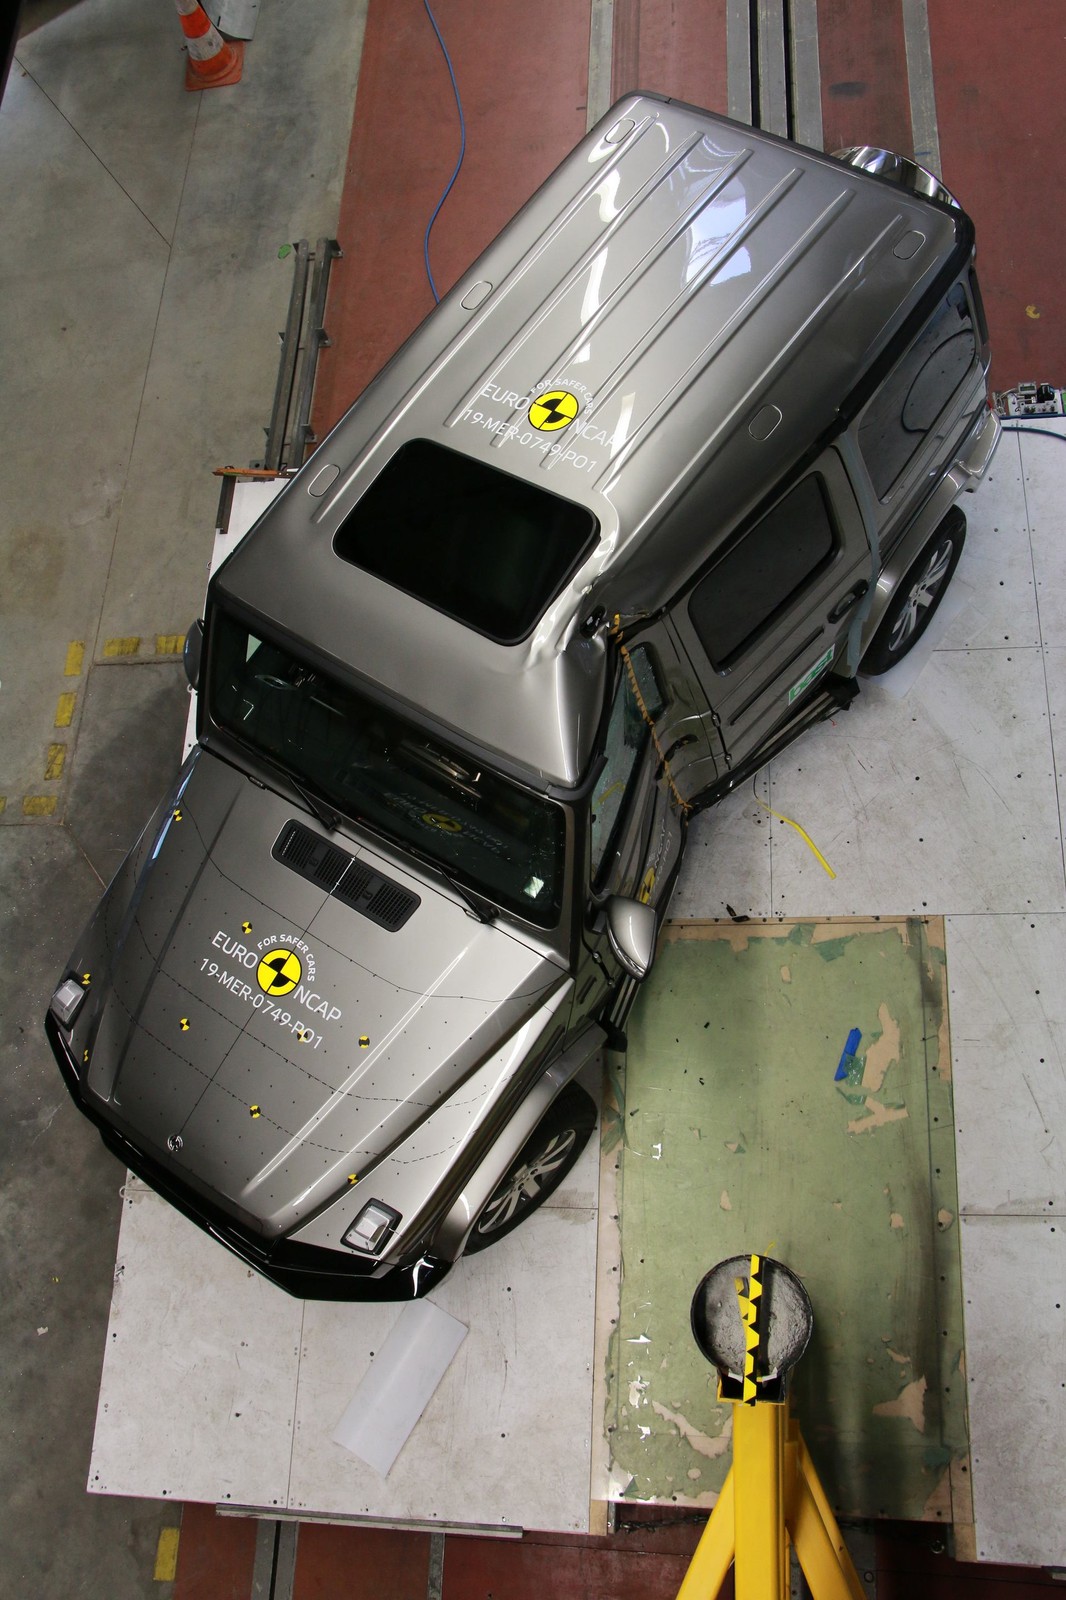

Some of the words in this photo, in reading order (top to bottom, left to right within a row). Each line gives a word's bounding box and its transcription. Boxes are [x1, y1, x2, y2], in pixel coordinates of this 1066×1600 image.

[480, 383, 530, 410] EURO
[530, 380, 553, 394] FOR
[555, 378, 587, 393] SAFER
[583, 392, 594, 415] CARS
[211, 930, 259, 969] EURO
[293, 984, 342, 1022] NCAP
[257, 935, 278, 951] FOR
[279, 934, 309, 954] SAFER
[305, 953, 316, 982] CARS
